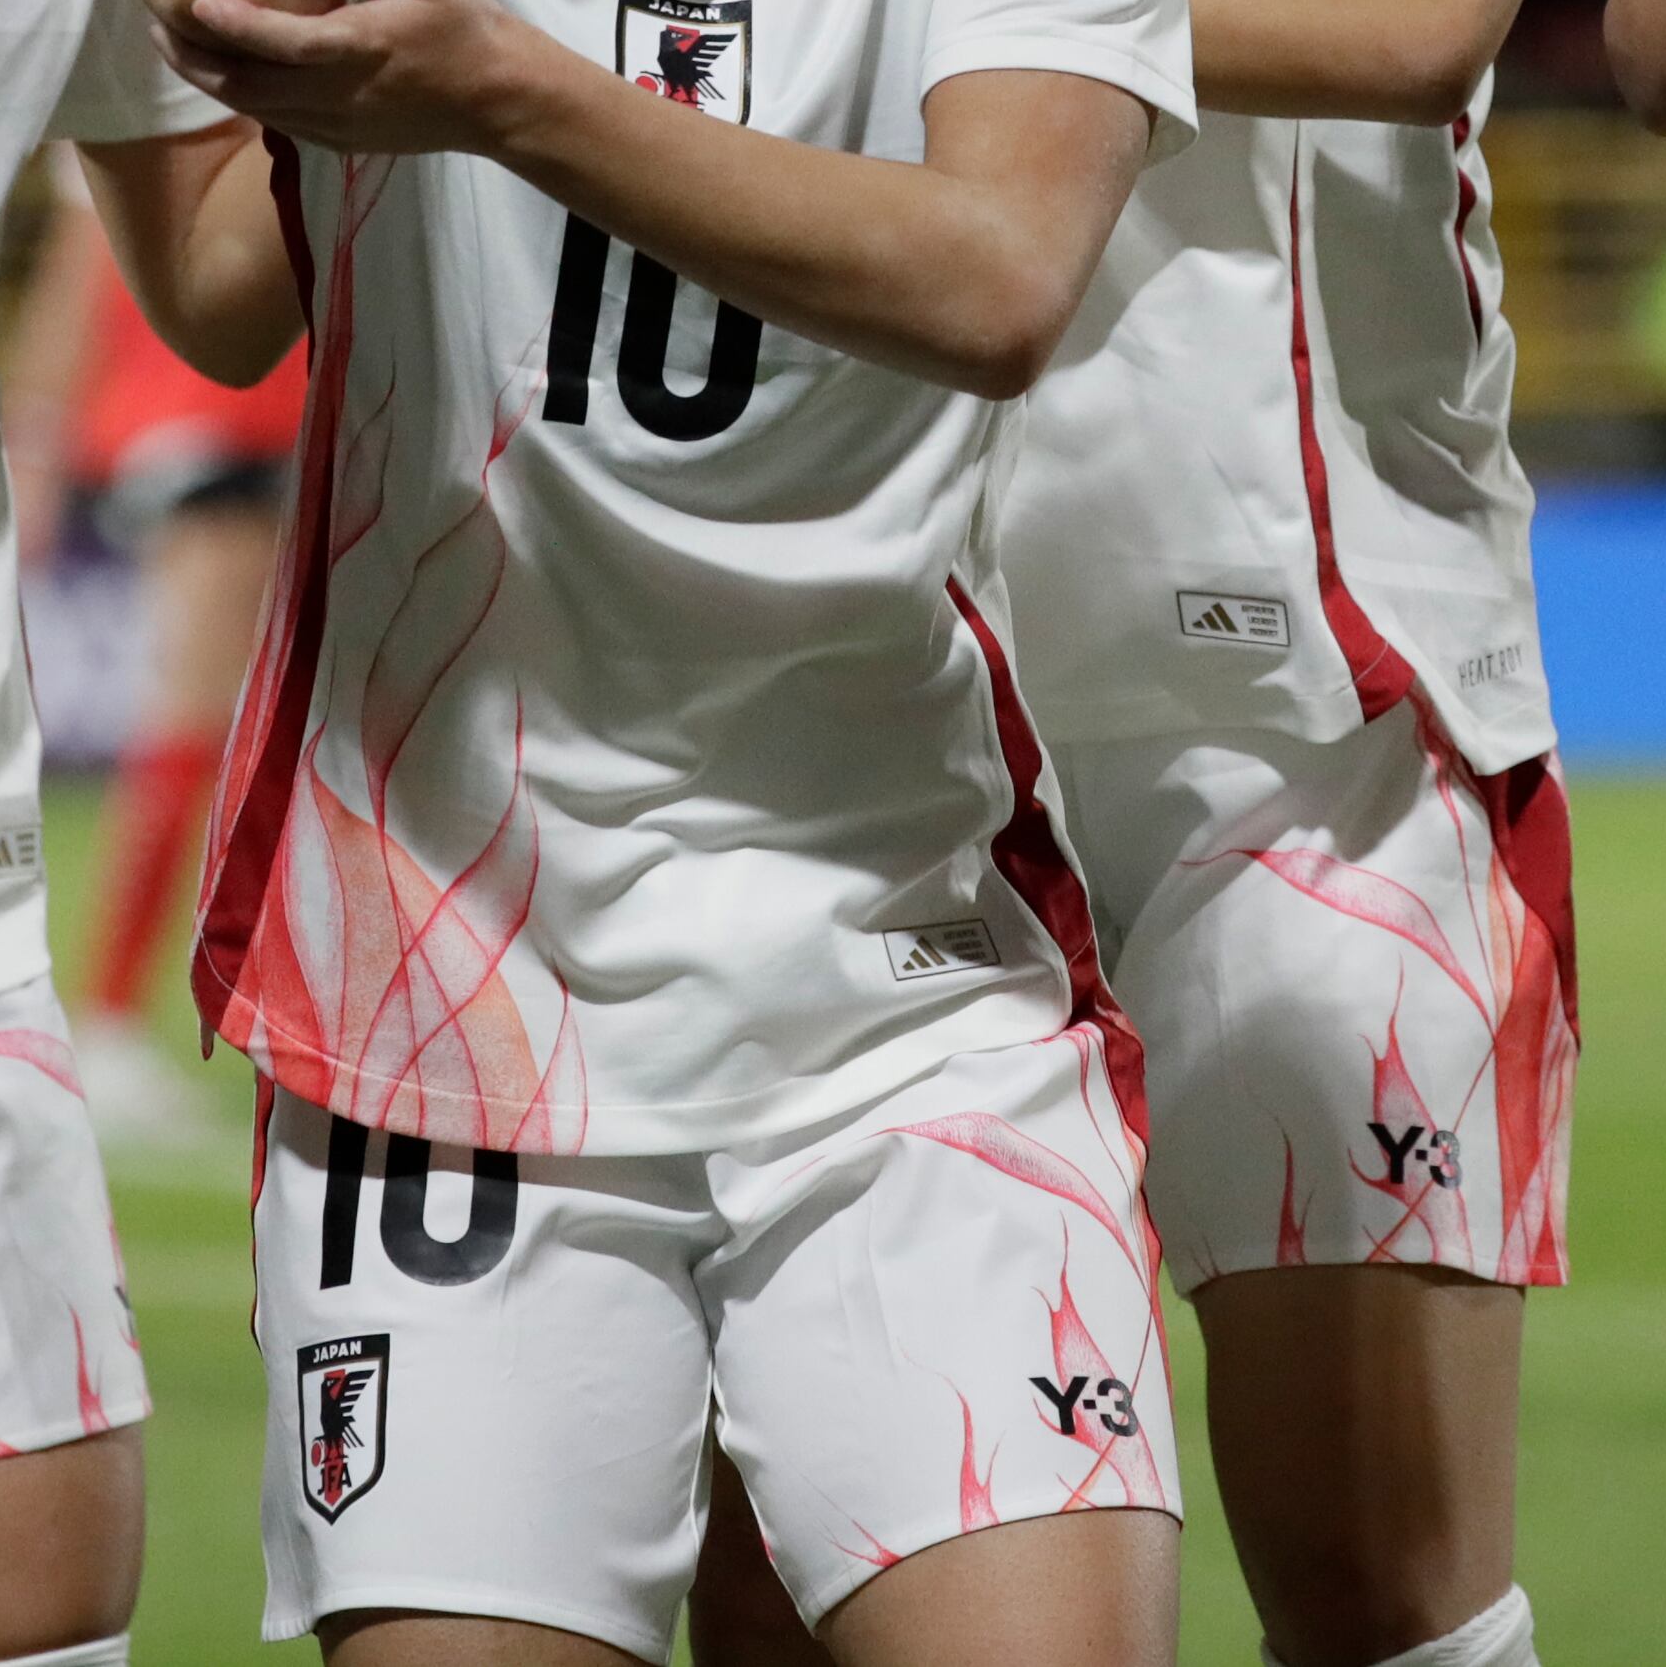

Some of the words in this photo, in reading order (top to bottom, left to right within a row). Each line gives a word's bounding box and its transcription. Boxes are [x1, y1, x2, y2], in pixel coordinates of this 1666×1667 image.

[542, 210, 764, 442] 10
[1366, 1122, 1462, 1189] Y-3
[312, 1339, 363, 1364] JAPAN
[1028, 1375, 1139, 1437] Y-3
[316, 1461, 353, 1496] JFA
